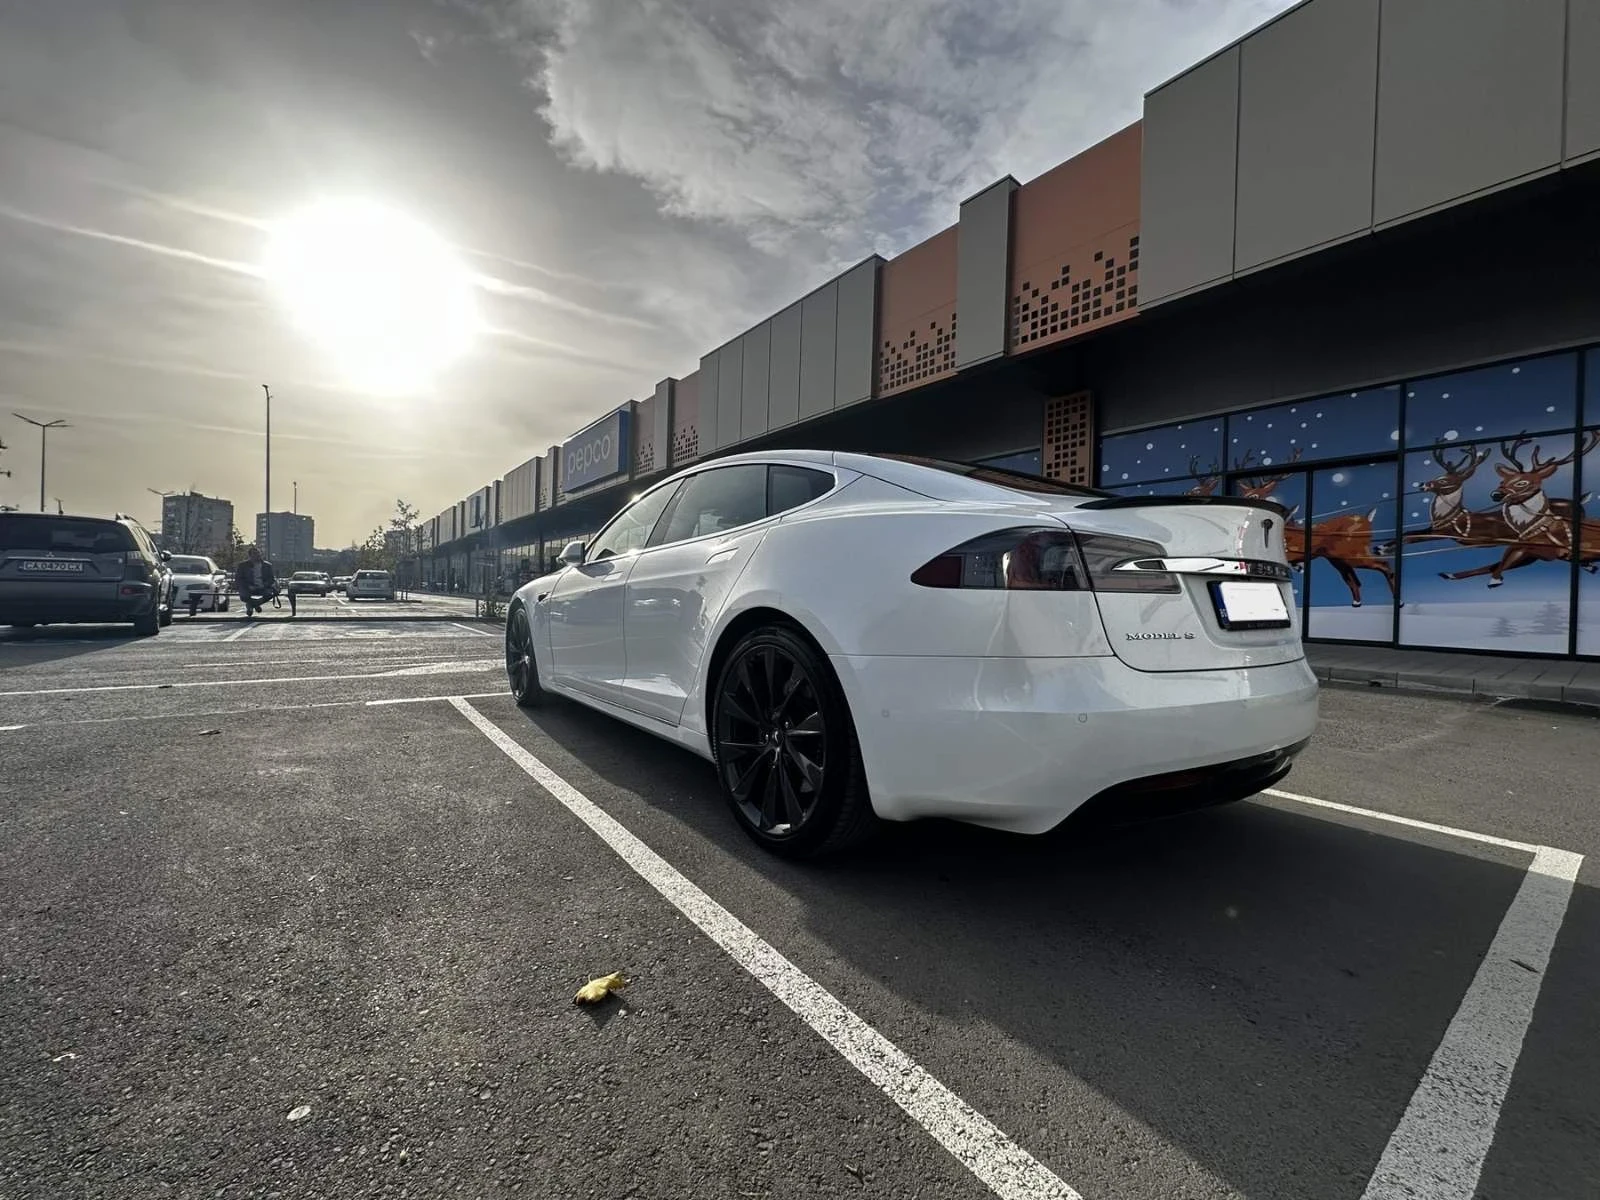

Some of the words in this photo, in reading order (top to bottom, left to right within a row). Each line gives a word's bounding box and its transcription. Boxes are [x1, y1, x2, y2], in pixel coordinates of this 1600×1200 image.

[568, 434, 611, 481] pepco
[1126, 632, 1182, 641] MODEL
[1184, 632, 1197, 640] S
